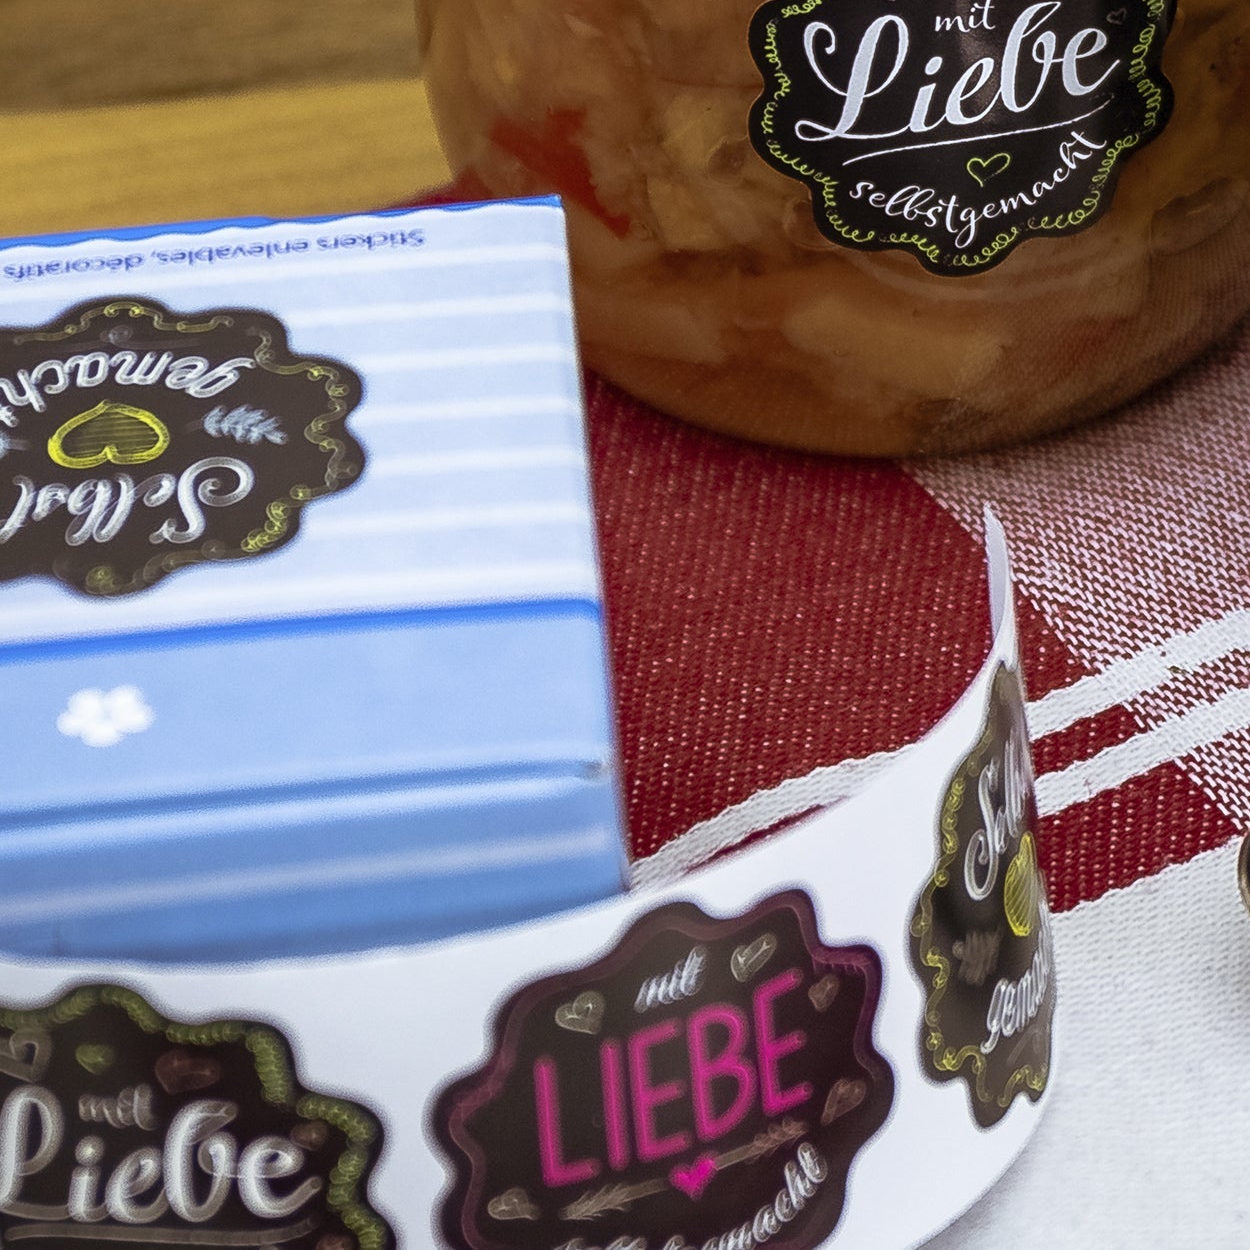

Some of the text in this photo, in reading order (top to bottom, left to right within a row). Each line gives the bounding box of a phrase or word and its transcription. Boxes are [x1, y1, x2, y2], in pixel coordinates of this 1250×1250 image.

[794, 1, 1121, 141] Liebe
[849, 130, 1107, 249] selbstgemacht
[2, 251, 146, 283] décoratifs
[317, 228, 426, 251] Stickers
[633, 944, 708, 1014] mit
[77, 1082, 157, 1131] mit
[533, 966, 814, 1189] LIEBE
